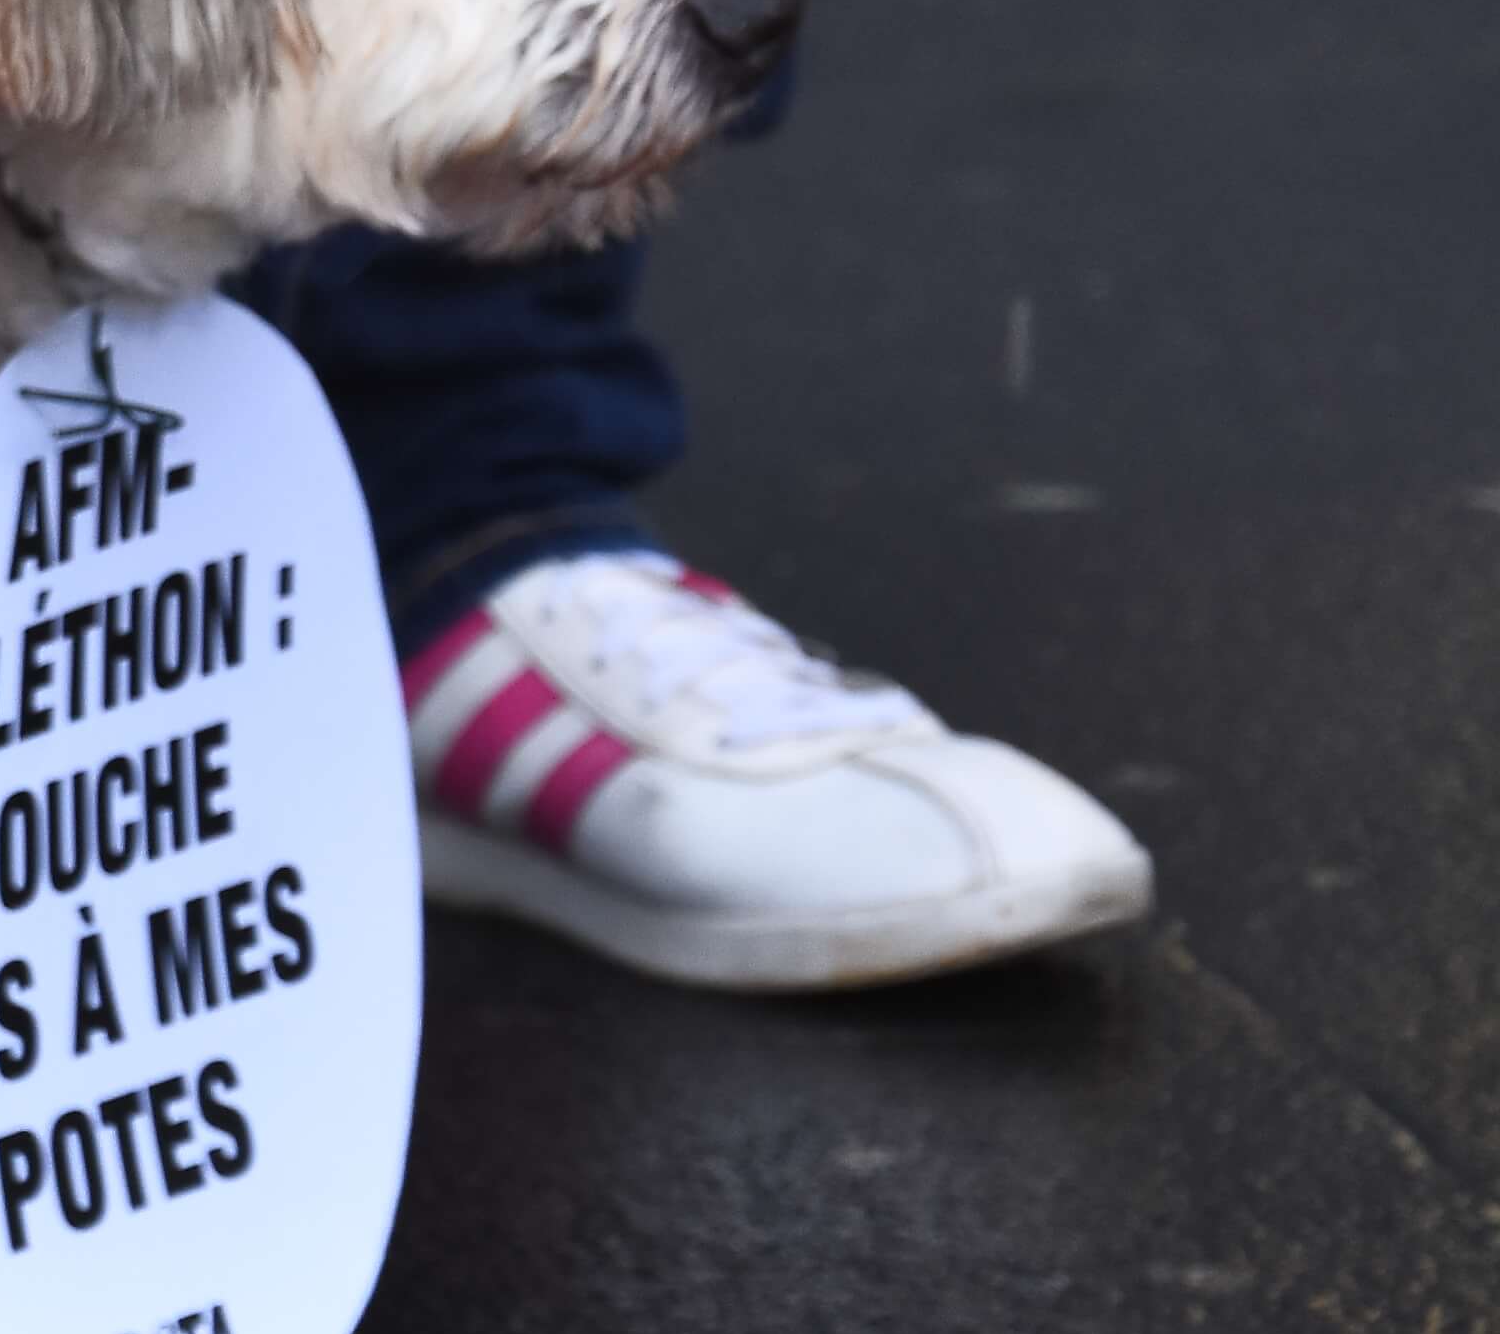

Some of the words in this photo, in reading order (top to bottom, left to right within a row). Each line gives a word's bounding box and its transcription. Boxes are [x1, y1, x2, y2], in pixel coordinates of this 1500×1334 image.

[8, 422, 196, 583] AFM-
[72, 905, 125, 1056] À
[146, 865, 314, 1027] MES
